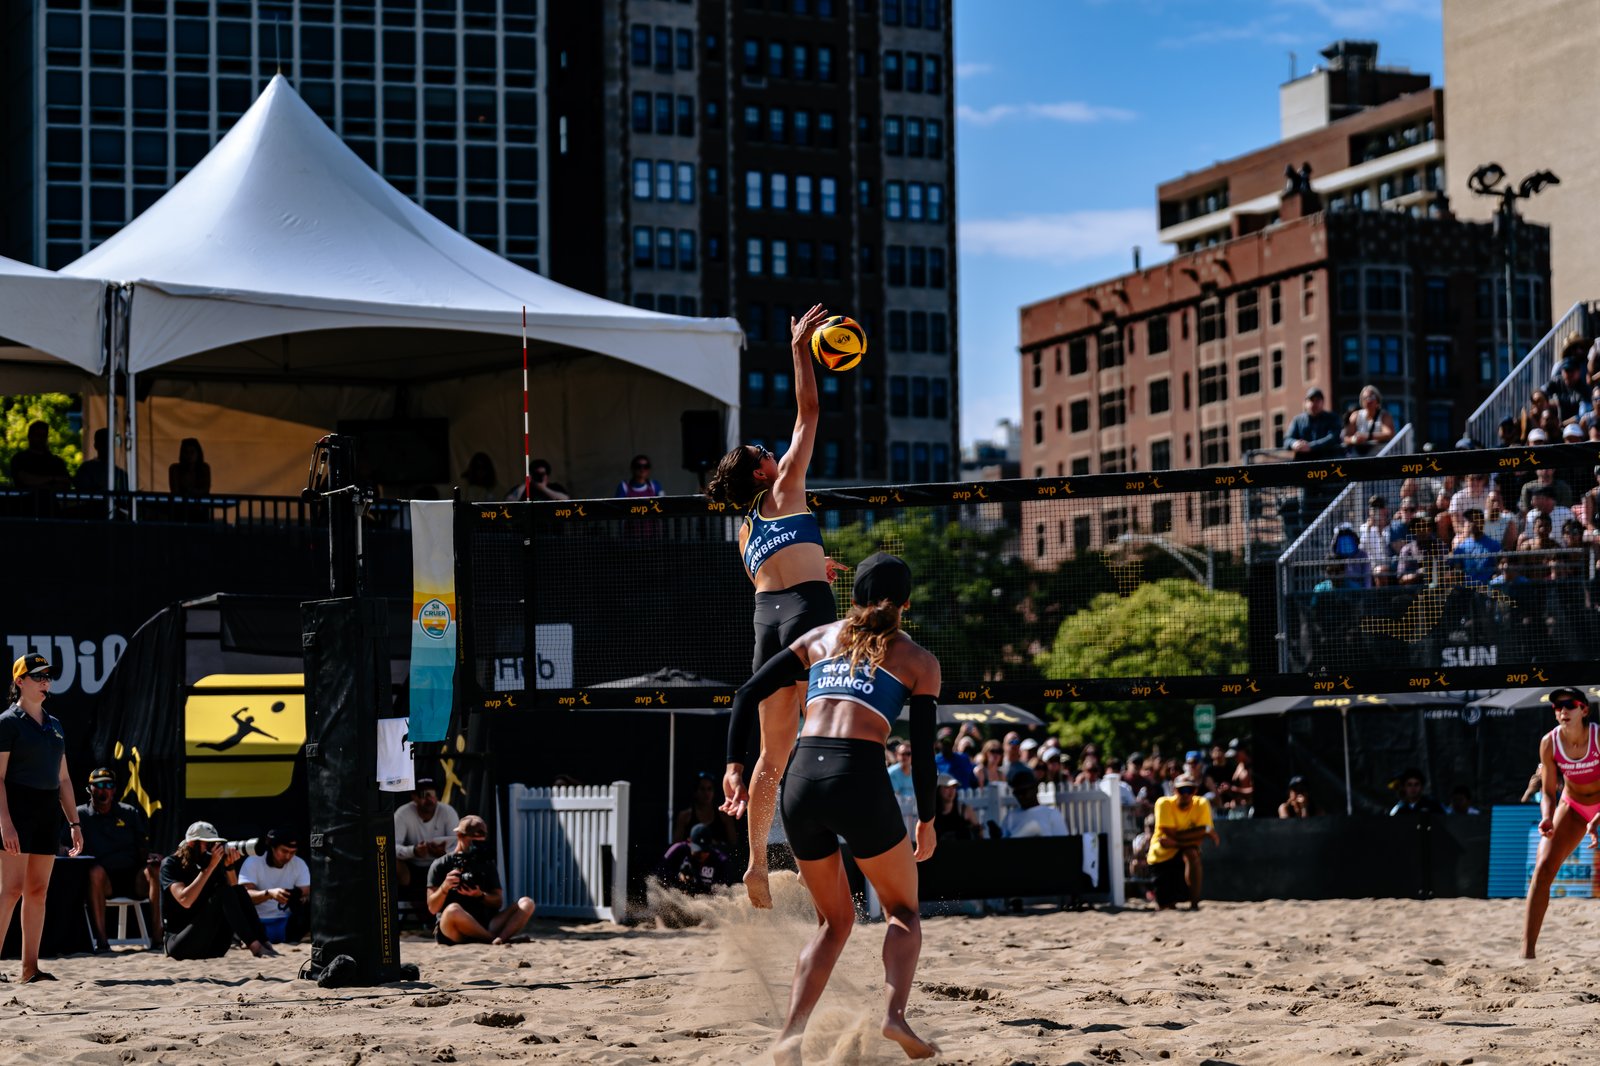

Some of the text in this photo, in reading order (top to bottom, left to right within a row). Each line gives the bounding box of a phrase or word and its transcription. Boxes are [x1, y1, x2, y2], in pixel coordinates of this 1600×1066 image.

[1498, 457, 1520, 468] avp
[1401, 464, 1423, 474] avp
[1215, 475, 1236, 485] avp
[1307, 470, 1328, 480] avp
[1037, 486, 1057, 496] avp
[1125, 481, 1145, 491] avp
[868, 495, 888, 504] avp
[952, 491, 971, 501] avp
[630, 506, 648, 514] avp
[707, 502, 726, 513] avp
[481, 511, 497, 520] avp
[555, 509, 571, 518] avp
[1441, 644, 1498, 668] SUN
[822, 663, 850, 674] avp
[1408, 678, 1431, 689] avp
[1506, 673, 1529, 684] avp
[817, 676, 874, 695] URANGO
[1221, 684, 1242, 694] avp
[1314, 681, 1335, 692] avp
[957, 691, 977, 701] avp
[1043, 689, 1063, 699] avp
[1131, 687, 1152, 696] avp
[484, 700, 501, 709] avp
[558, 697, 576, 706] avp
[634, 696, 653, 705] avp
[712, 695, 731, 705] avp
